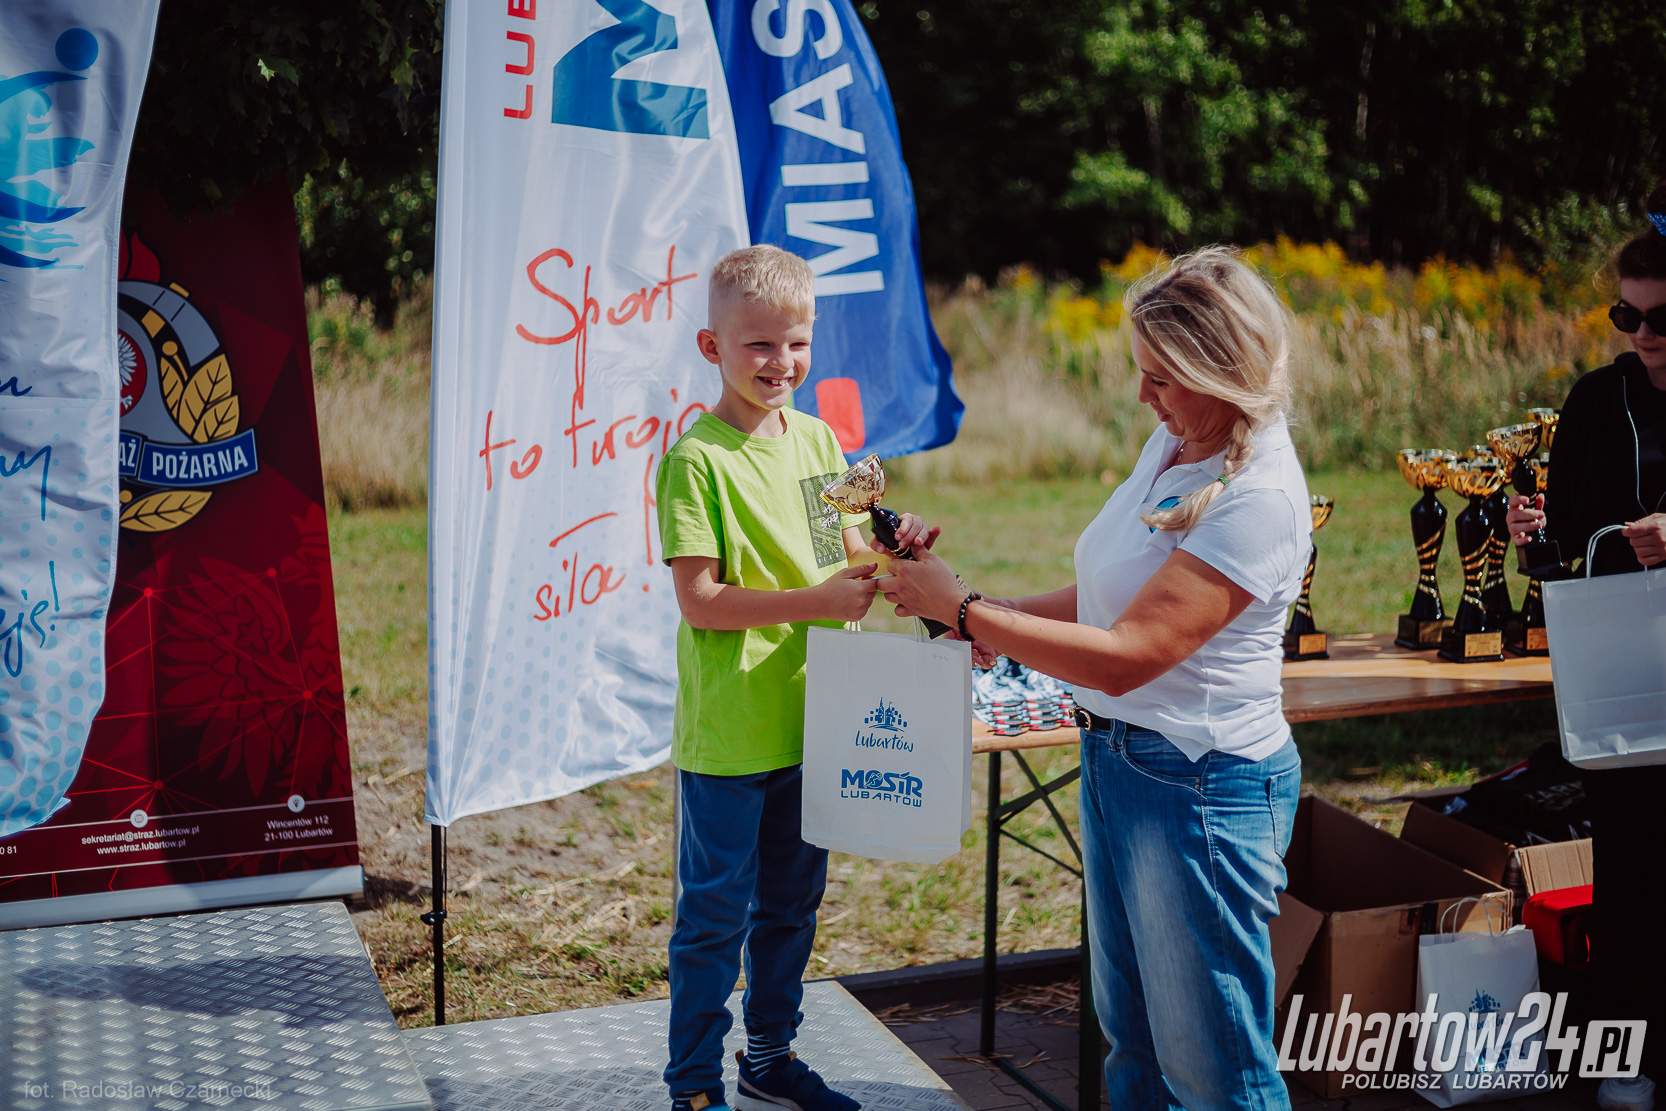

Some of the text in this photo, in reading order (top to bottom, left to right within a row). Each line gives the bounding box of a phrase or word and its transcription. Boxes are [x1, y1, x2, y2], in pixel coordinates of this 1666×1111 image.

[751, 0, 885, 298] MIAS
[516, 245, 698, 410] Sport
[152, 445, 249, 480] POŻARNA
[480, 410, 543, 491] to
[855, 730, 914, 753] Lubartów
[315, 814, 330, 826] 112
[96, 839, 186, 856] www.straz.lubartow.pl
